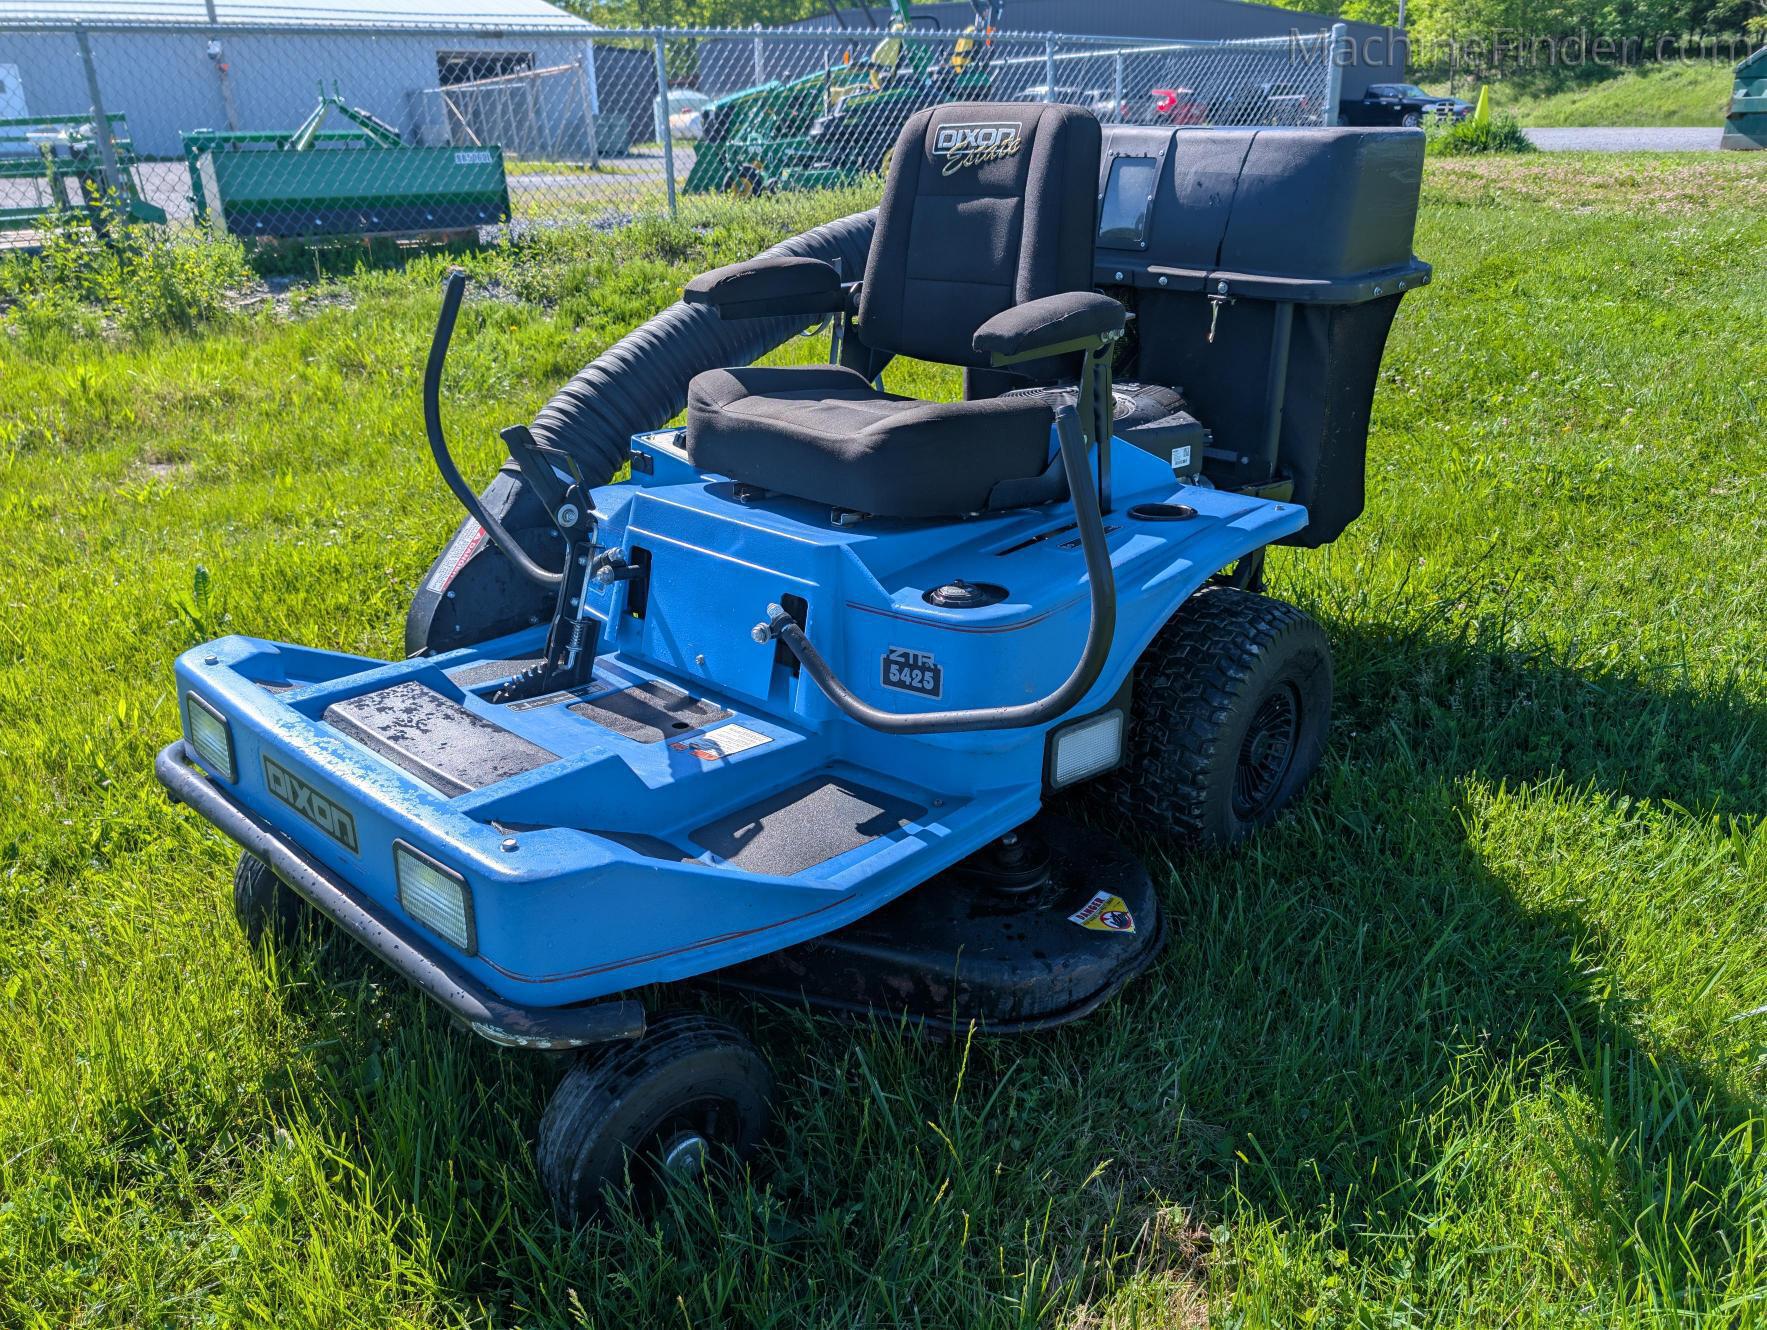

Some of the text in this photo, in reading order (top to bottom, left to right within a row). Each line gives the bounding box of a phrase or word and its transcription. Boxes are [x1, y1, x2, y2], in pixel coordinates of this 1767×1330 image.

[938, 128, 1015, 148] DIXON
[888, 646, 935, 668] ZTR
[889, 664, 935, 689] 5425
[265, 759, 356, 848] DIXON
